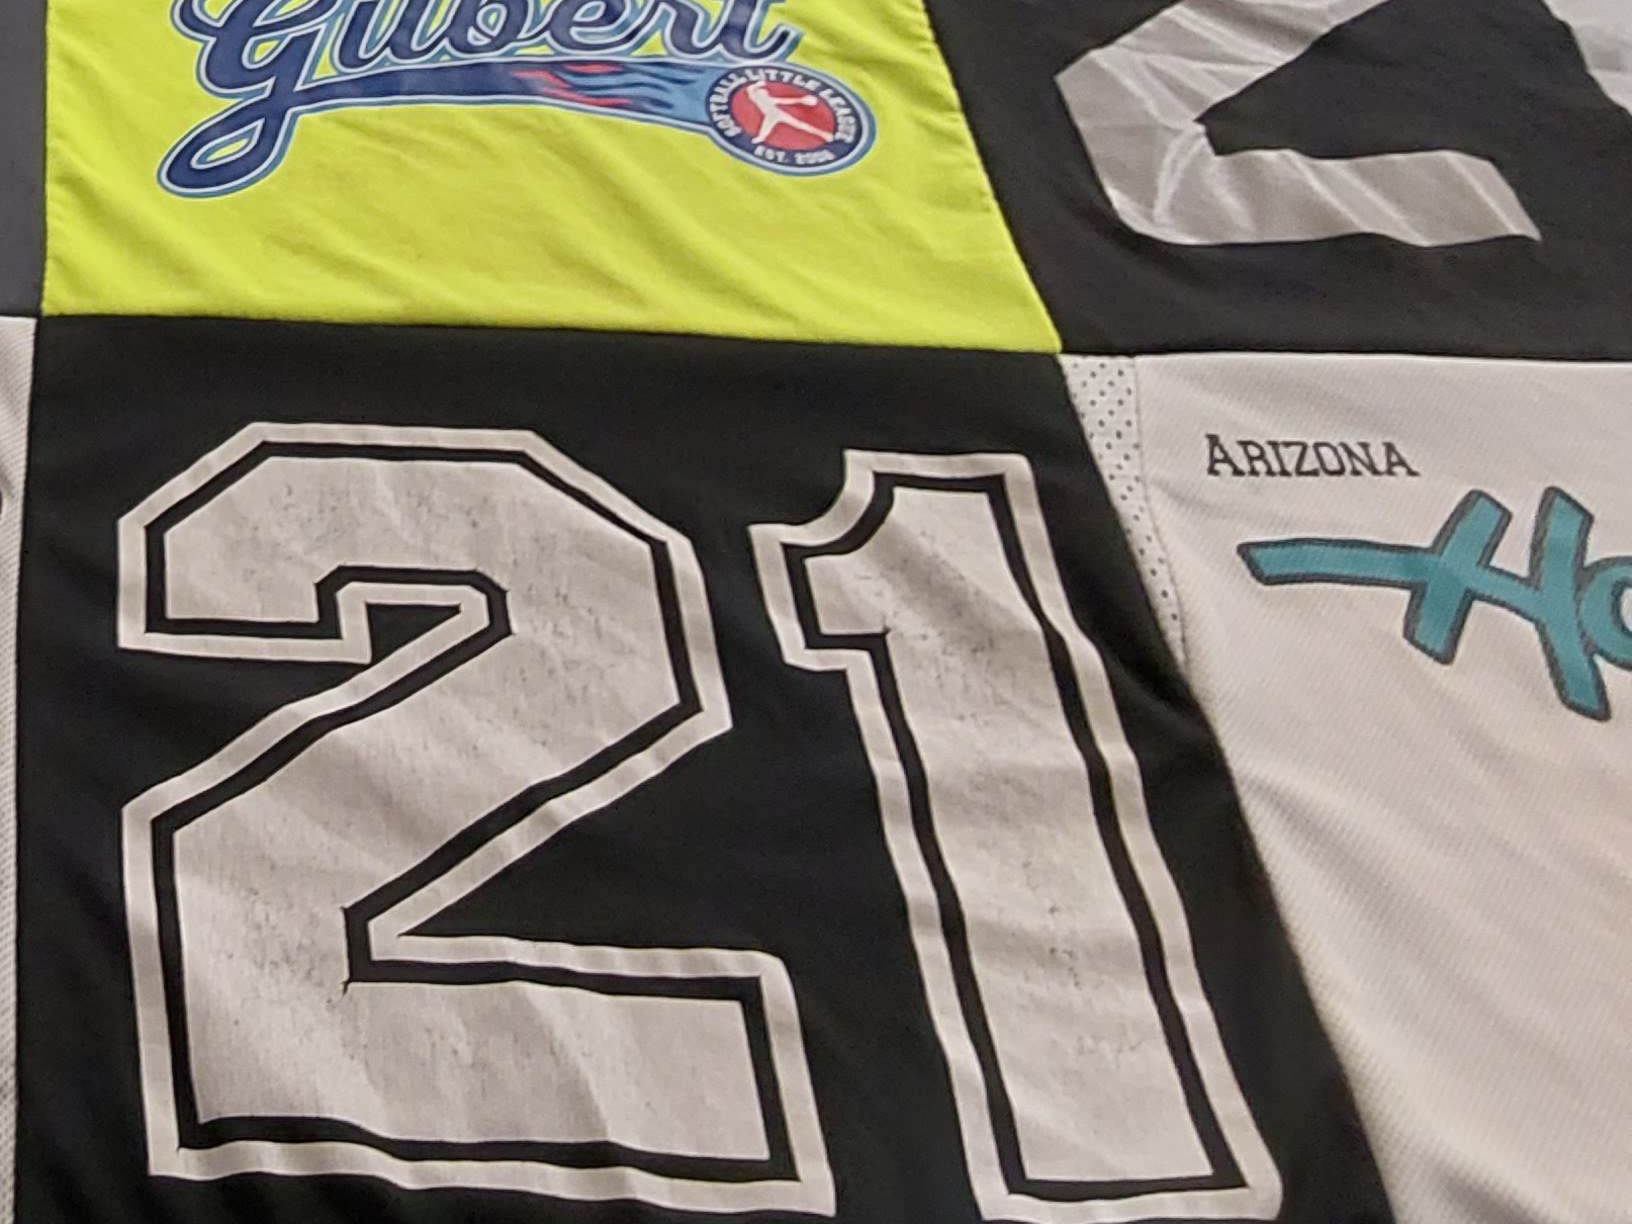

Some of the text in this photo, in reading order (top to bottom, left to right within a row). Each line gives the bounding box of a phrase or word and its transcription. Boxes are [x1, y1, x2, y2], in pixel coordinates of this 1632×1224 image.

[744, 67, 822, 91] LITTLE
[1205, 433, 1421, 477] ARIZONA
[116, 421, 1285, 1224] 21
